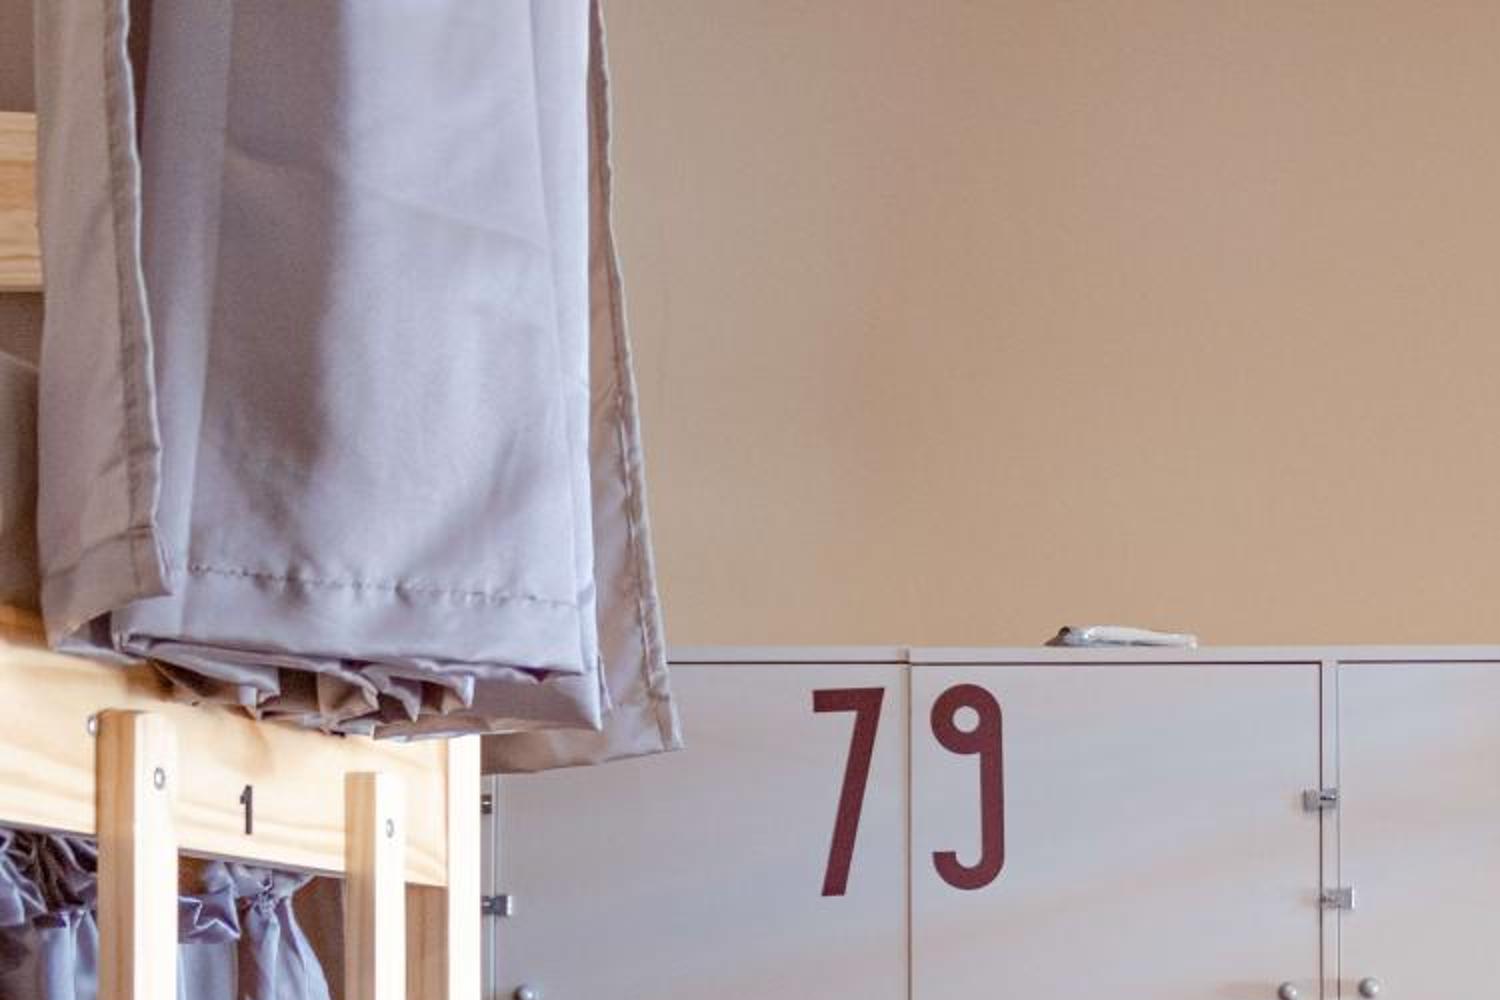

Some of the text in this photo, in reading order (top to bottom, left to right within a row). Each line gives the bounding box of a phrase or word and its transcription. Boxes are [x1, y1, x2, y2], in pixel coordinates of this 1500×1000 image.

[239, 784, 253, 835] 1
[811, 685, 886, 898] 7
[929, 682, 1006, 892] 9
